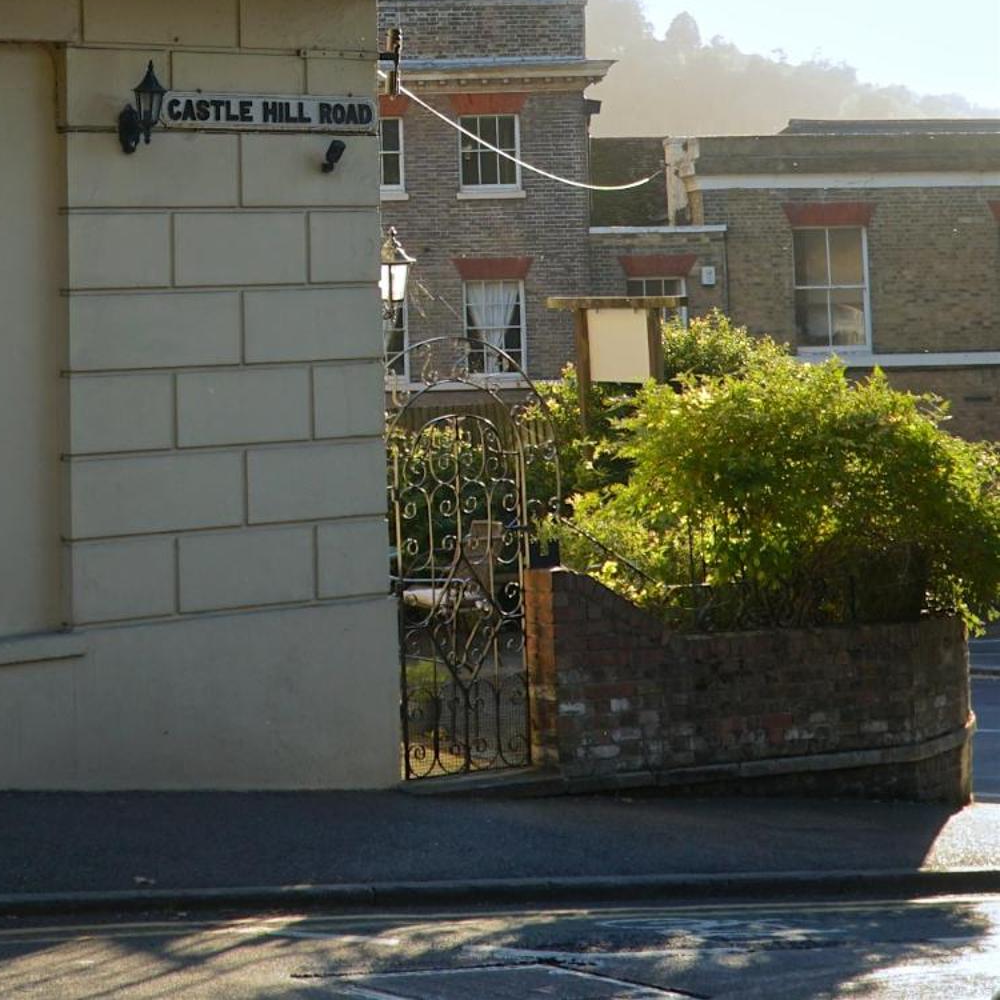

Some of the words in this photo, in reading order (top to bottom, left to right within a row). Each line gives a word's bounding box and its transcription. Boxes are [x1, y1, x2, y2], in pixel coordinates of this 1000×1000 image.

[167, 98, 253, 122] CASTLE
[262, 101, 311, 124] HILL
[319, 103, 373, 125] ROAD
